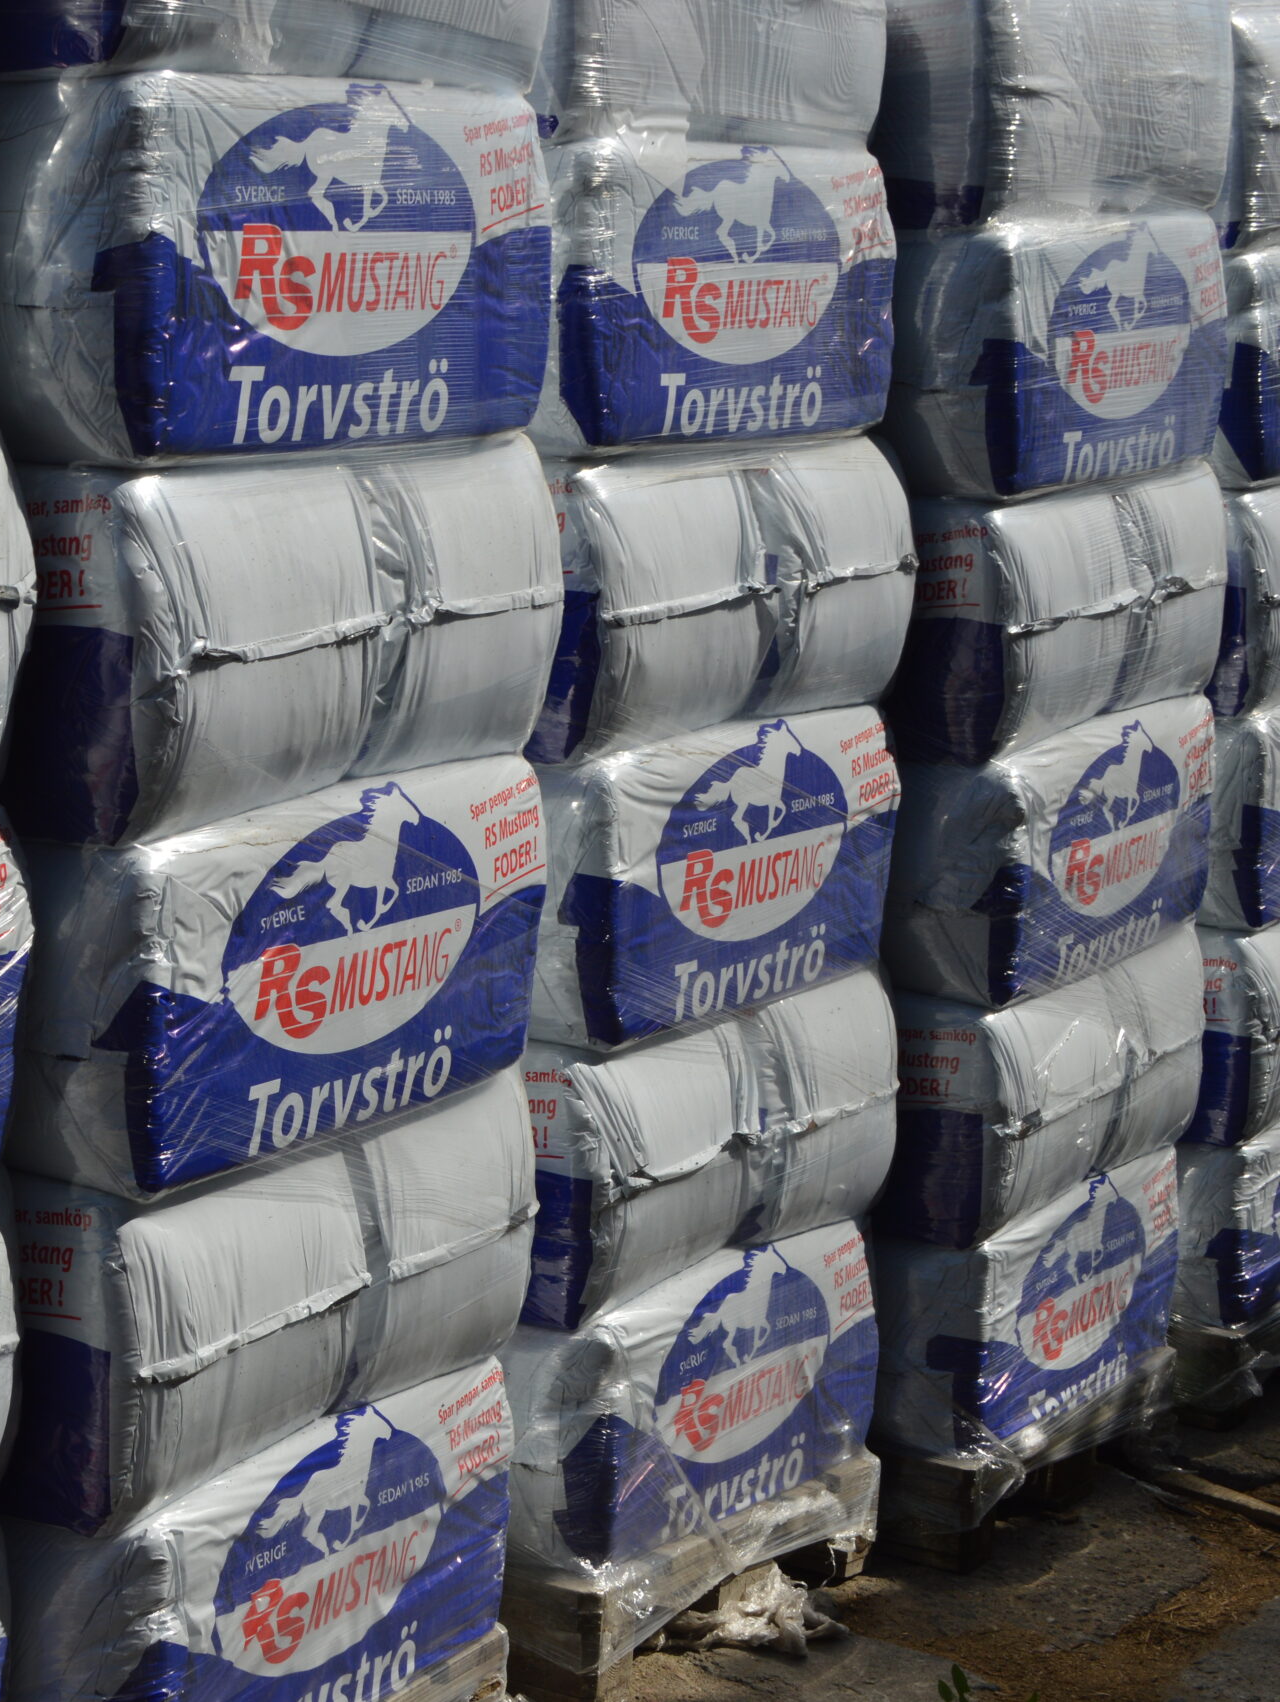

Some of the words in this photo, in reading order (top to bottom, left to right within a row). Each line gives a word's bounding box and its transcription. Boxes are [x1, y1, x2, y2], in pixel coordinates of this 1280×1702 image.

[480, 151, 493, 177] RS
[235, 184, 285, 203] SVERIGE
[396, 189, 431, 205] SEDAN
[434, 189, 456, 205] 1985
[661, 226, 699, 241] SVERIGE
[234, 223, 316, 331] RS
[316, 252, 447, 313] MUSTANG
[662, 256, 722, 344] RS
[722, 278, 820, 330] MUSTANG
[1066, 330, 1109, 404] RS
[228, 358, 449, 445] Torvströ
[660, 366, 822, 437] Torvströ
[1062, 415, 1175, 484] Torvströ
[851, 757, 862, 778] RS
[470, 801, 487, 822] Spar
[488, 786, 516, 814] pengar,
[791, 797, 816, 813] SEDAN
[817, 792, 835, 807] 1985
[484, 823, 497, 850] RS
[499, 805, 539, 842] Mustang
[683, 818, 717, 838] SVERIGE
[406, 875, 439, 894] SEDAN
[440, 868, 463, 887] 1985
[679, 849, 734, 929] RS
[734, 842, 826, 910] MUSTANG
[1065, 838, 1104, 905] RS
[260, 905, 306, 934] SVERIGE
[1056, 898, 1163, 986] Torvströ
[254, 942, 331, 1039] RS
[329, 928, 453, 1016] MUSTANG
[673, 922, 826, 1023] Torvströ
[248, 1024, 453, 1158] Torvströ
[35, 1208, 92, 1232] samköp
[834, 1268, 844, 1290] RS
[775, 1313, 801, 1330] SEDAN
[1032, 1297, 1070, 1361] RS
[438, 1403, 454, 1425] Spar
[448, 1424, 461, 1451] RS
[463, 1400, 502, 1441] Mustang
[674, 1378, 723, 1452] RS
[721, 1354, 810, 1431] MUSTANG
[378, 1484, 407, 1506] SEDAN
[245, 1541, 287, 1576] SVERIGE
[242, 1578, 309, 1664] RS
[307, 1530, 418, 1635] MUSTANG
